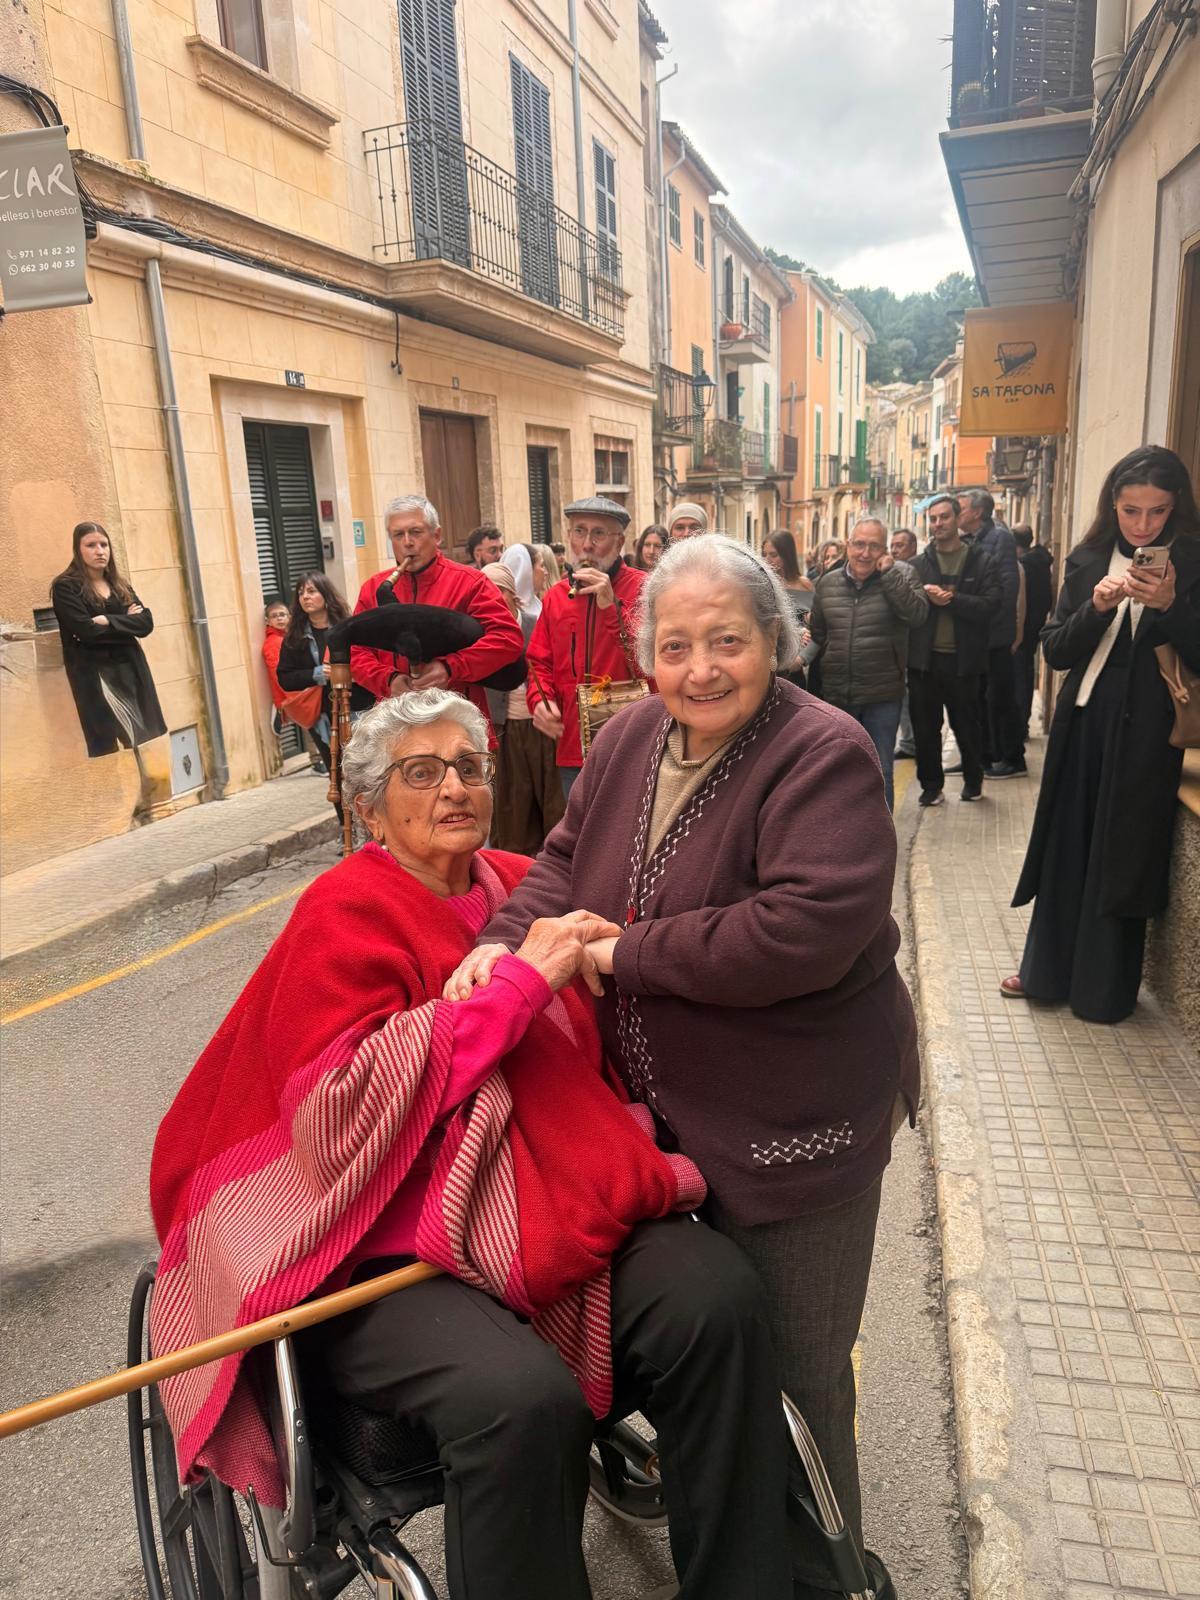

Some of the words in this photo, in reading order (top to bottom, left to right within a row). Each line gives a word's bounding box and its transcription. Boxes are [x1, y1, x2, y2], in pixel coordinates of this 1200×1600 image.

[0, 211, 29, 222] ellesa
[37, 207, 79, 218] benestar
[19, 250, 34, 259] 971
[39, 249, 49, 257] 14
[52, 247, 62, 255] 82
[65, 246, 76, 254] 20
[21, 264, 36, 273] 662
[39, 263, 50, 272] 30
[52, 261, 63, 269] 40
[65, 259, 76, 268] 55
[972, 386, 990, 398] SA
[995, 383, 1055, 397] TAFONA
